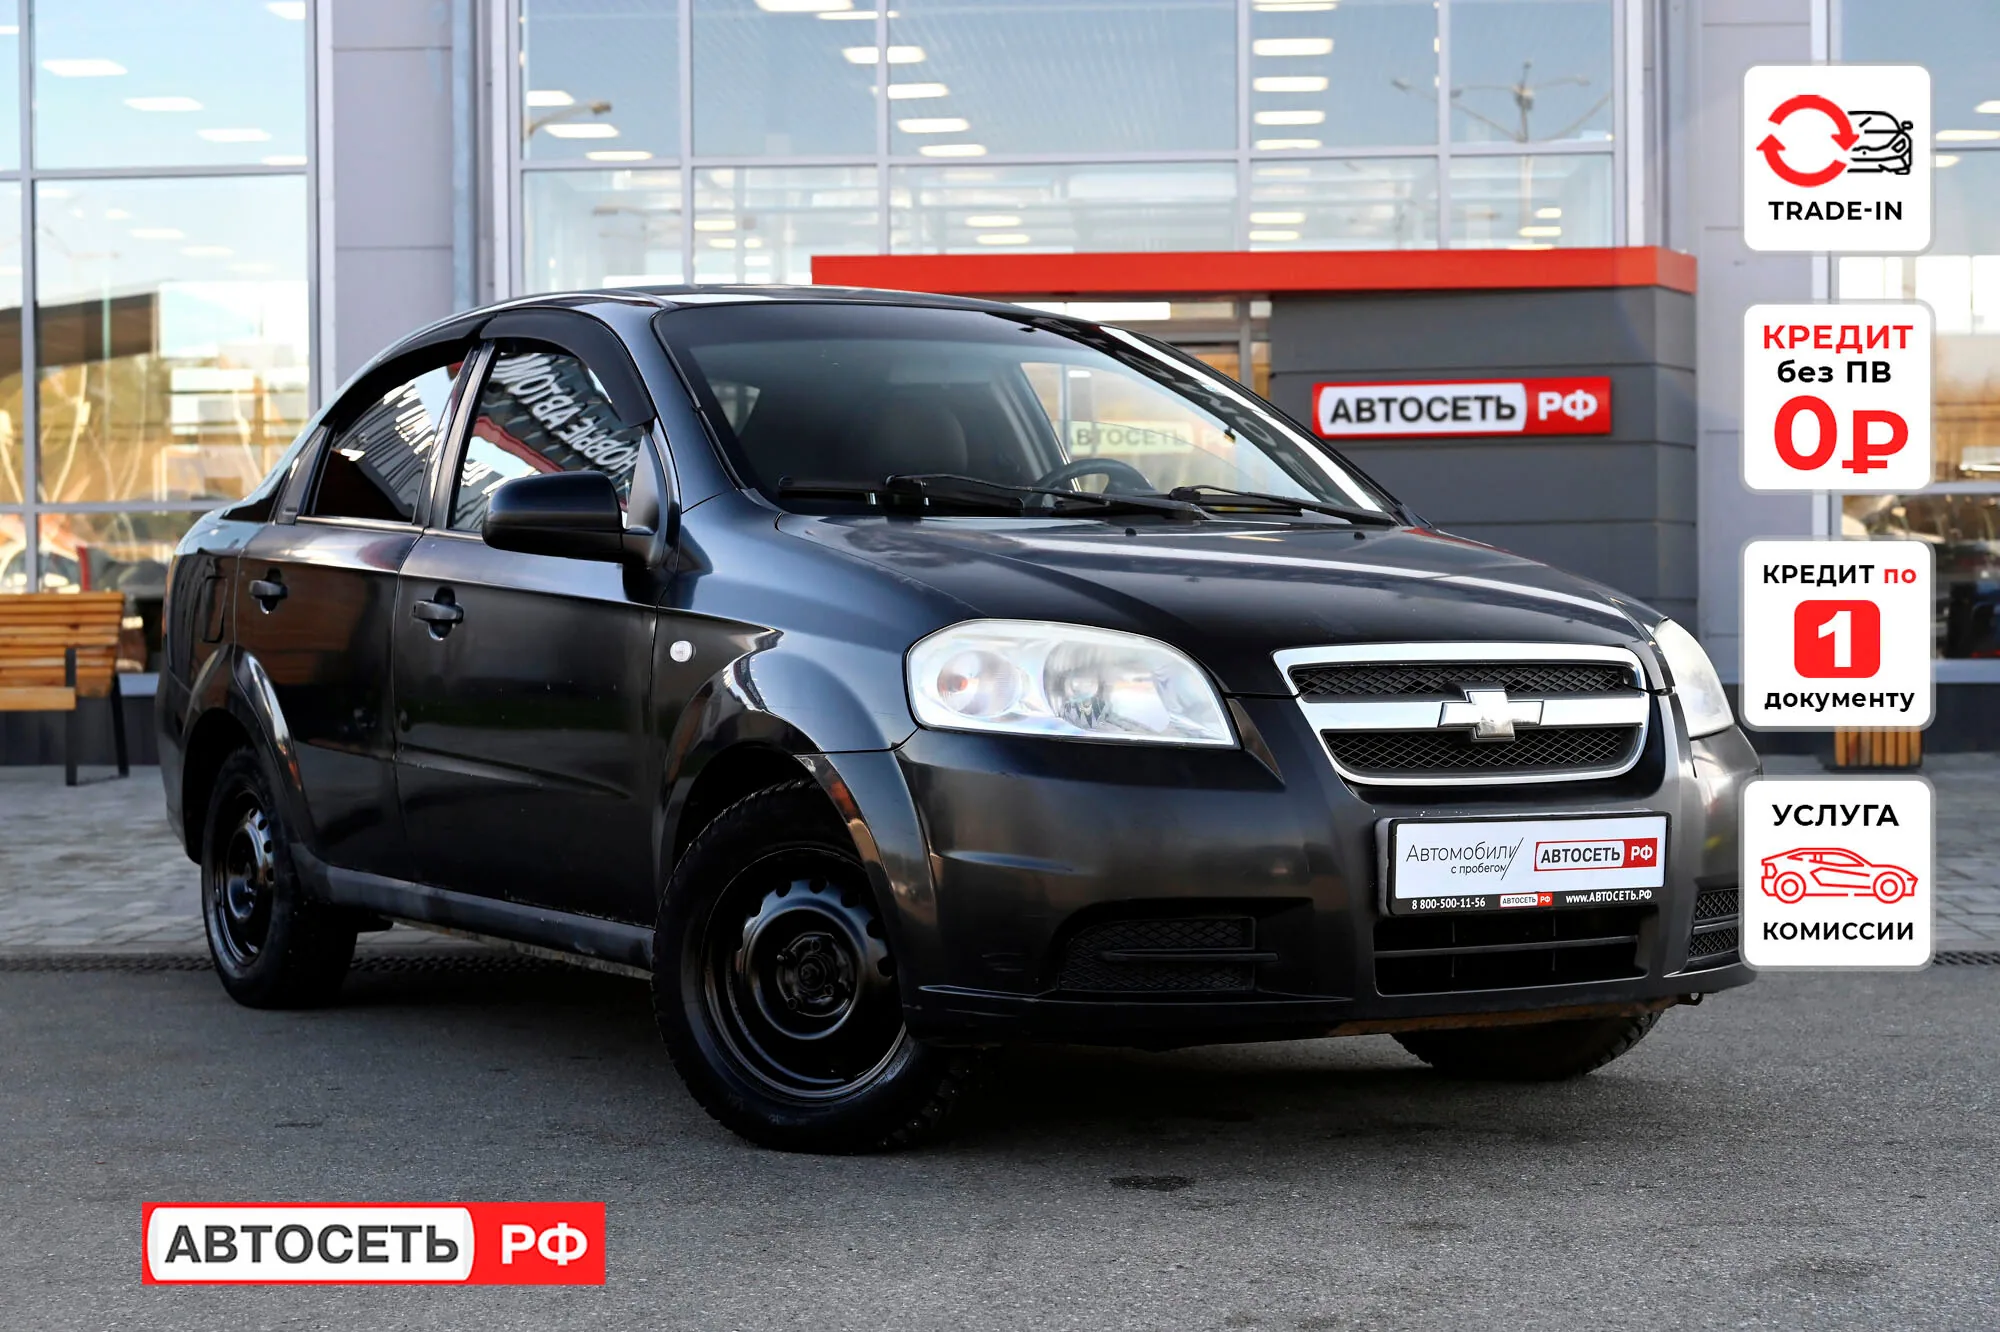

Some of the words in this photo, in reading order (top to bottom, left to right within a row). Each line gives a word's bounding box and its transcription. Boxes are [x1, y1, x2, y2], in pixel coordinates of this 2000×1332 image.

[1330, 395, 1517, 424] АВТОСЕТЬ
[1537, 389, 1599, 421] РФ
[1070, 428, 1187, 447] ВТОСЕТЬ
[1540, 847, 1621, 864] АВТОСЕТЬ
[1630, 844, 1654, 861] РФ
[1411, 899, 1418, 910] 8
[1420, 897, 1486, 910] 800-500-11-56
[1502, 896, 1537, 905] АВТОСЕТЬ
[1540, 895, 1551, 904] РФ
[1565, 889, 1653, 904] www.АВТОСЕТЬ.РФ
